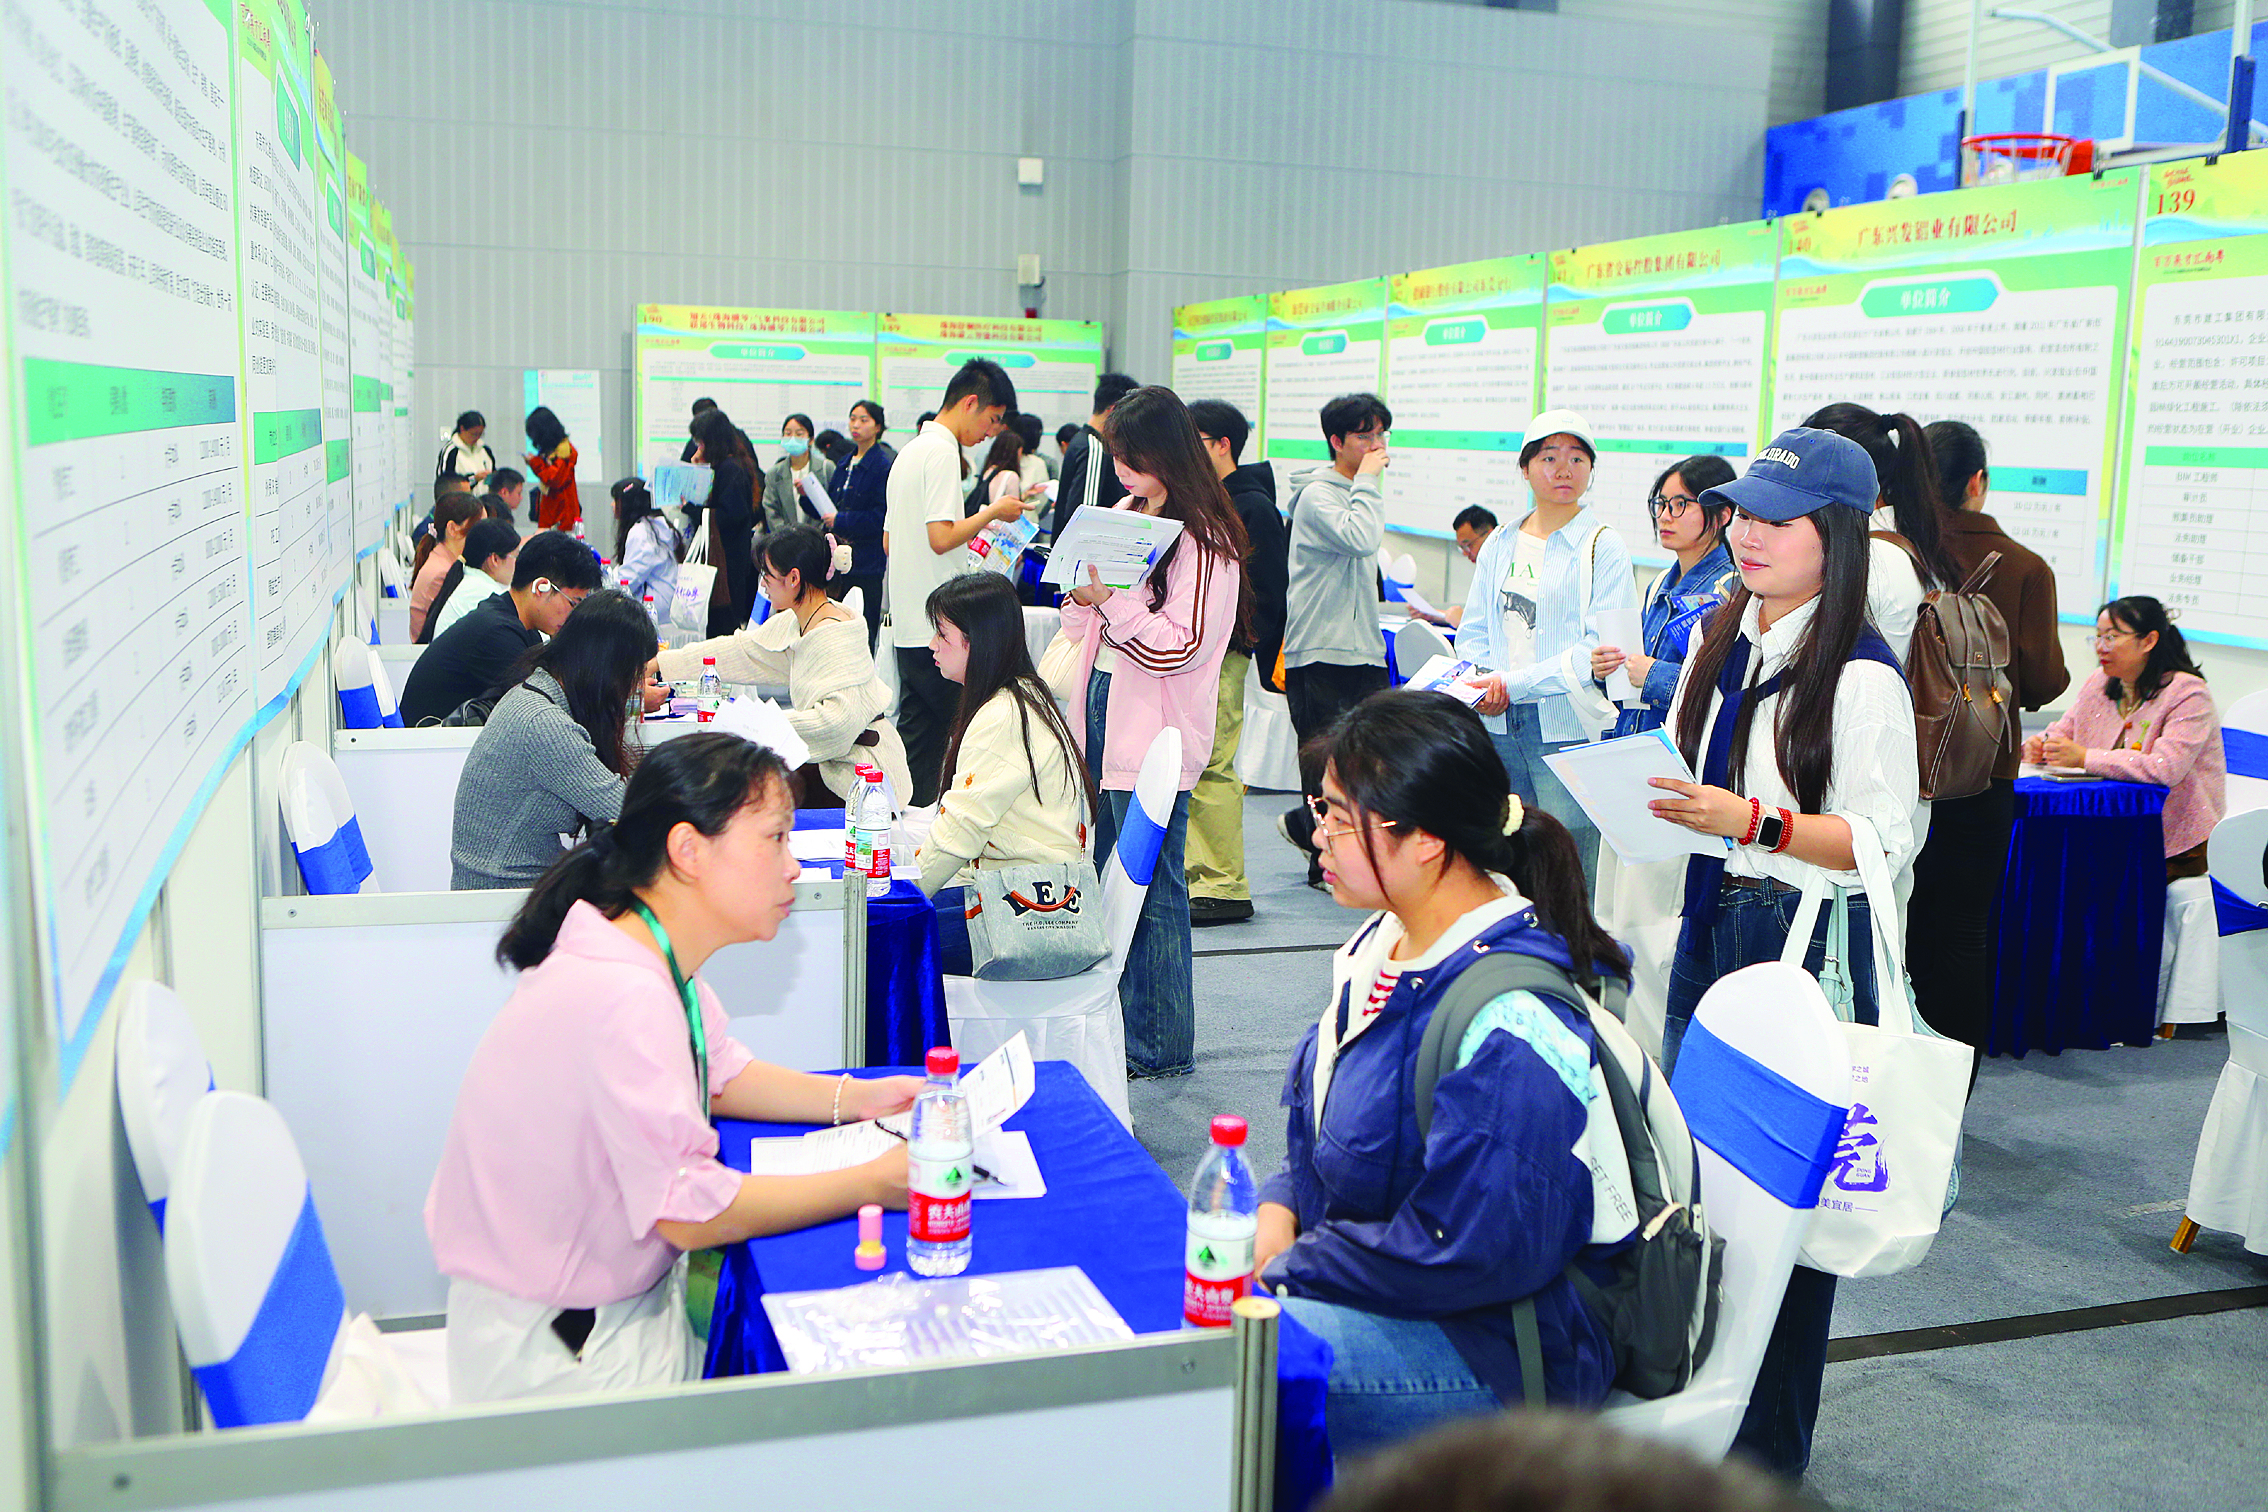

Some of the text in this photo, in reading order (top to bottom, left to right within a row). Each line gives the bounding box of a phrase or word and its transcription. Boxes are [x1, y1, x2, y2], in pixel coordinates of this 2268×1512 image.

[2157, 188, 2196, 215] 139
[1857, 208, 2018, 248] 广东兴发铝业有限公司
[1901, 287, 1951, 310] 单位简介
[1753, 446, 1801, 470] OLORADO
[1002, 880, 1083, 917] LEE
[1591, 1156, 1634, 1222] SET FREE
[1817, 1197, 1854, 1213] 美宜居
